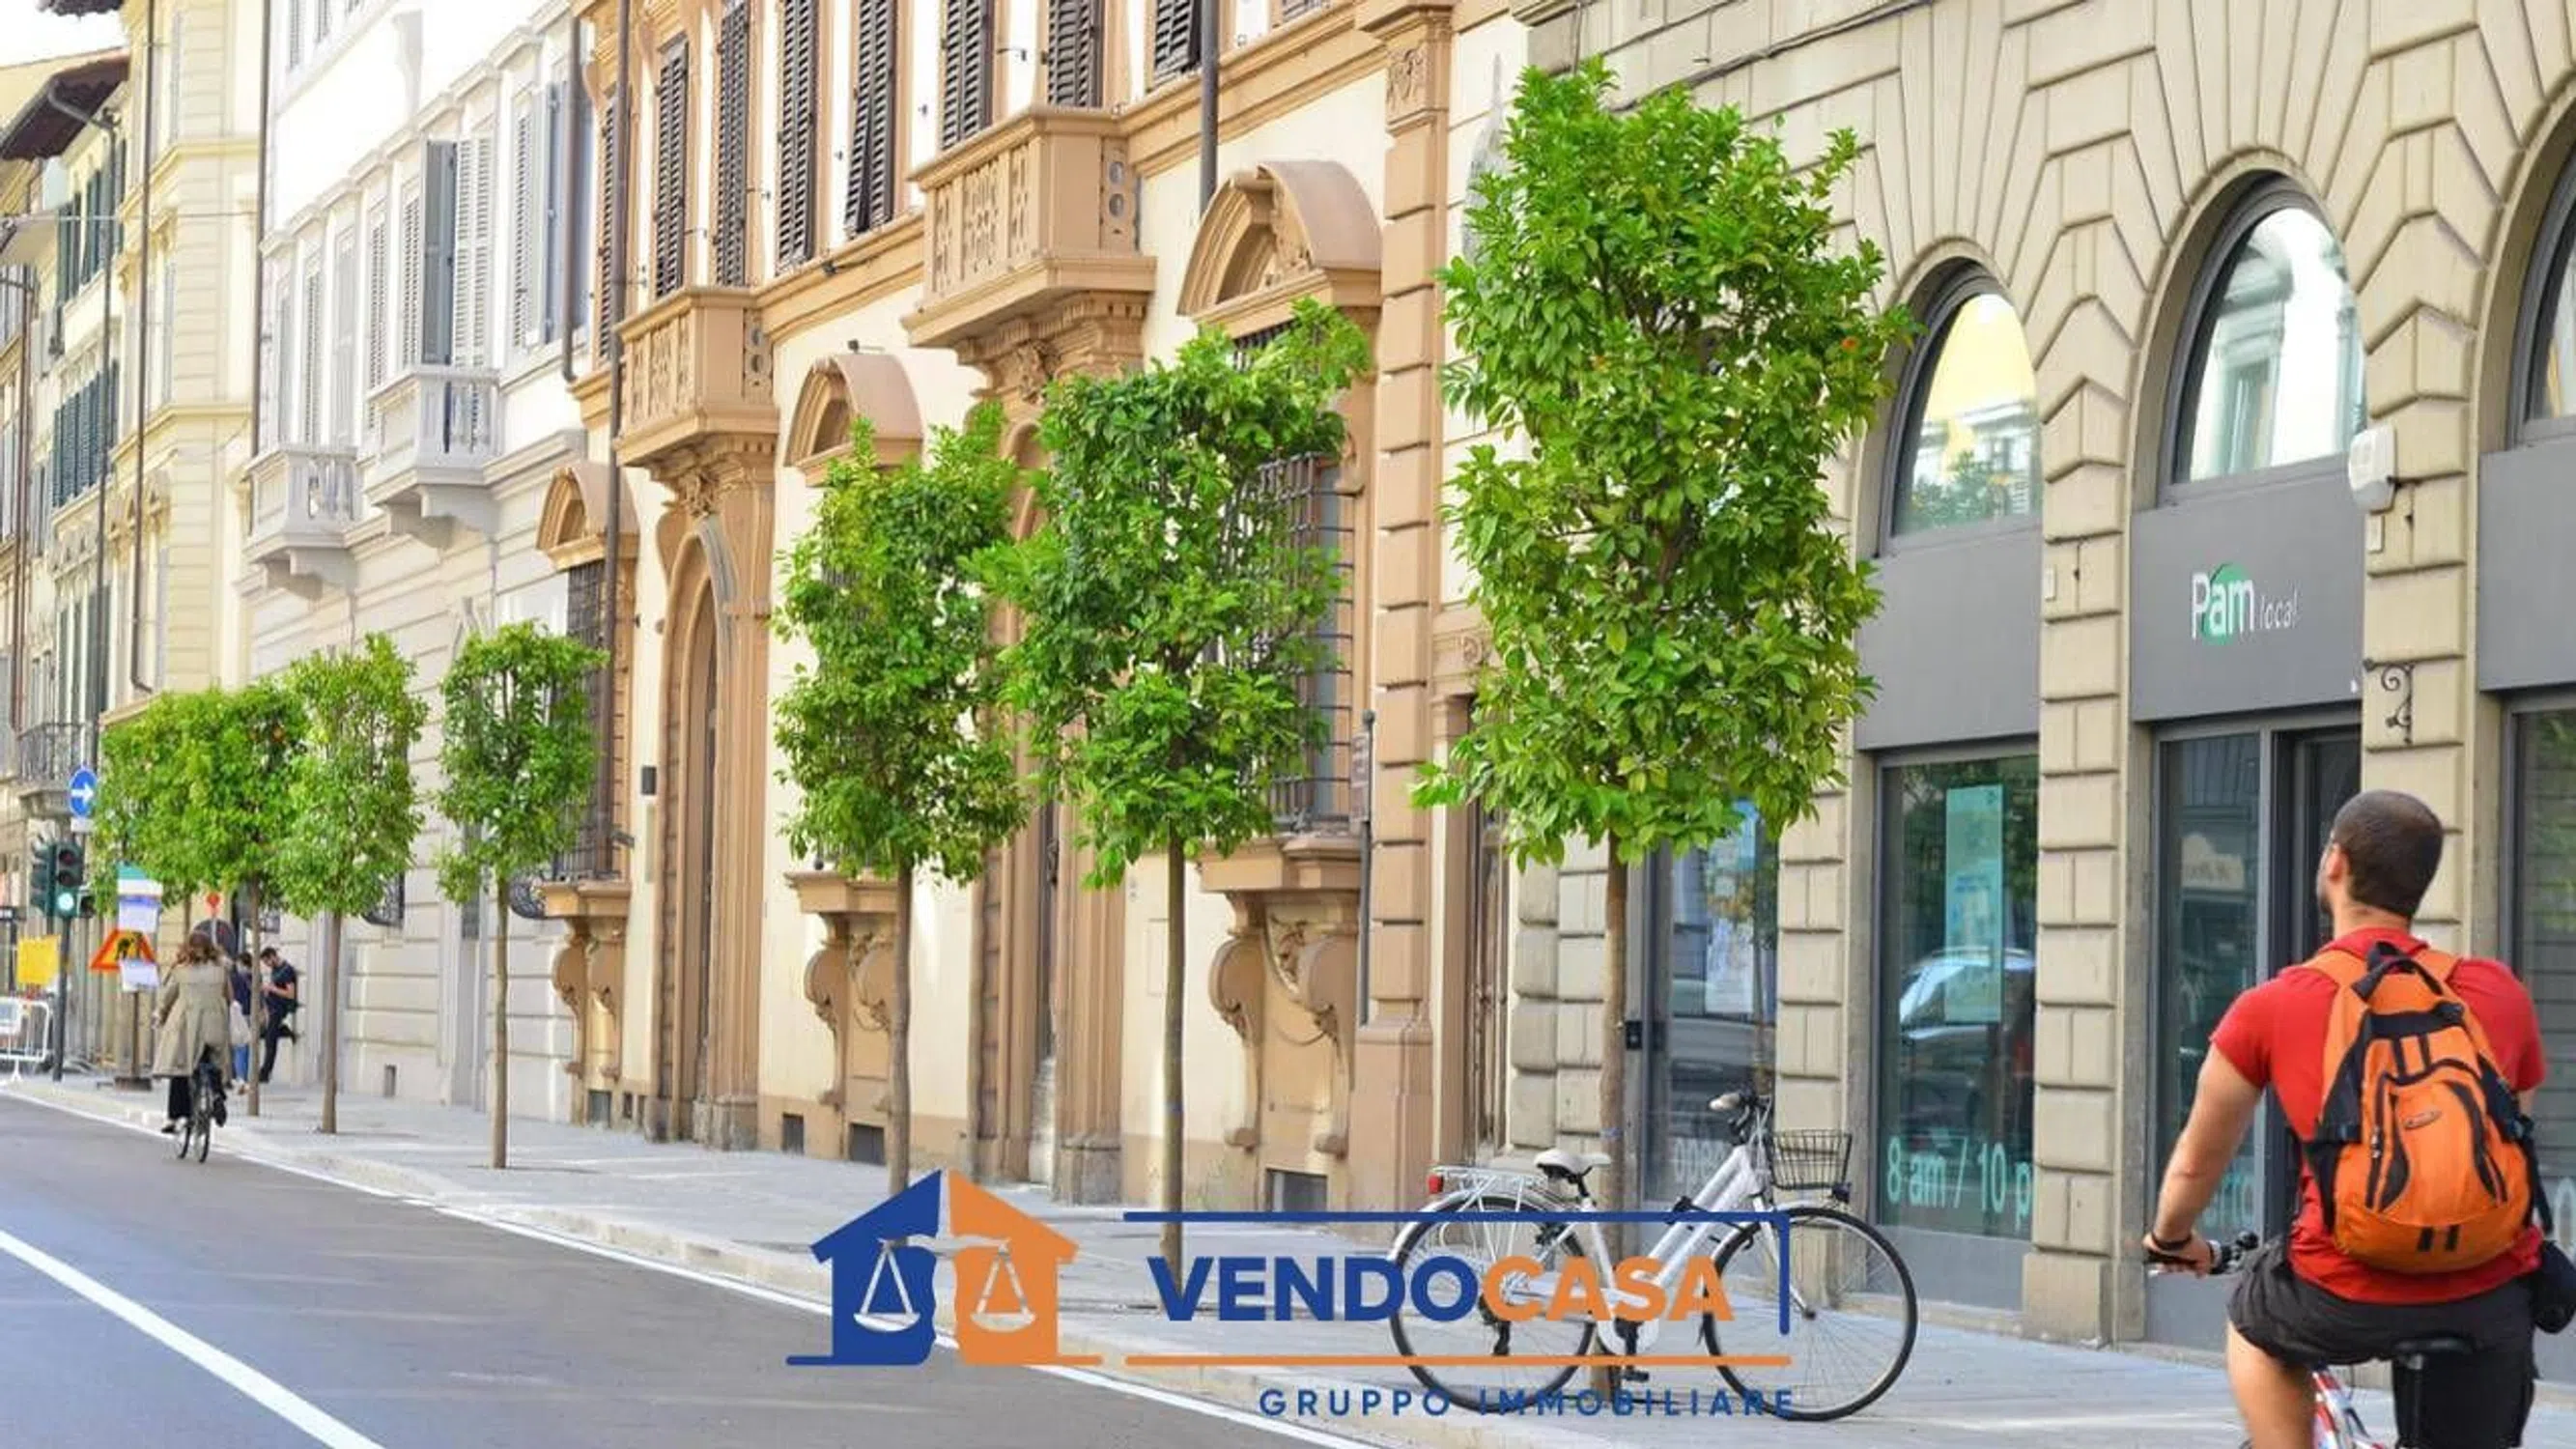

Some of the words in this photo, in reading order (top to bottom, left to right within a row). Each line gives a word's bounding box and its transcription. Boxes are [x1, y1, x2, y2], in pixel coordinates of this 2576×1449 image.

[2191, 572, 2254, 639] Pam
[2259, 588, 2299, 630] local
[1887, 1135, 1901, 1205] 8
[1909, 1152, 1946, 1208] am
[1978, 1143, 2006, 1213] 10
